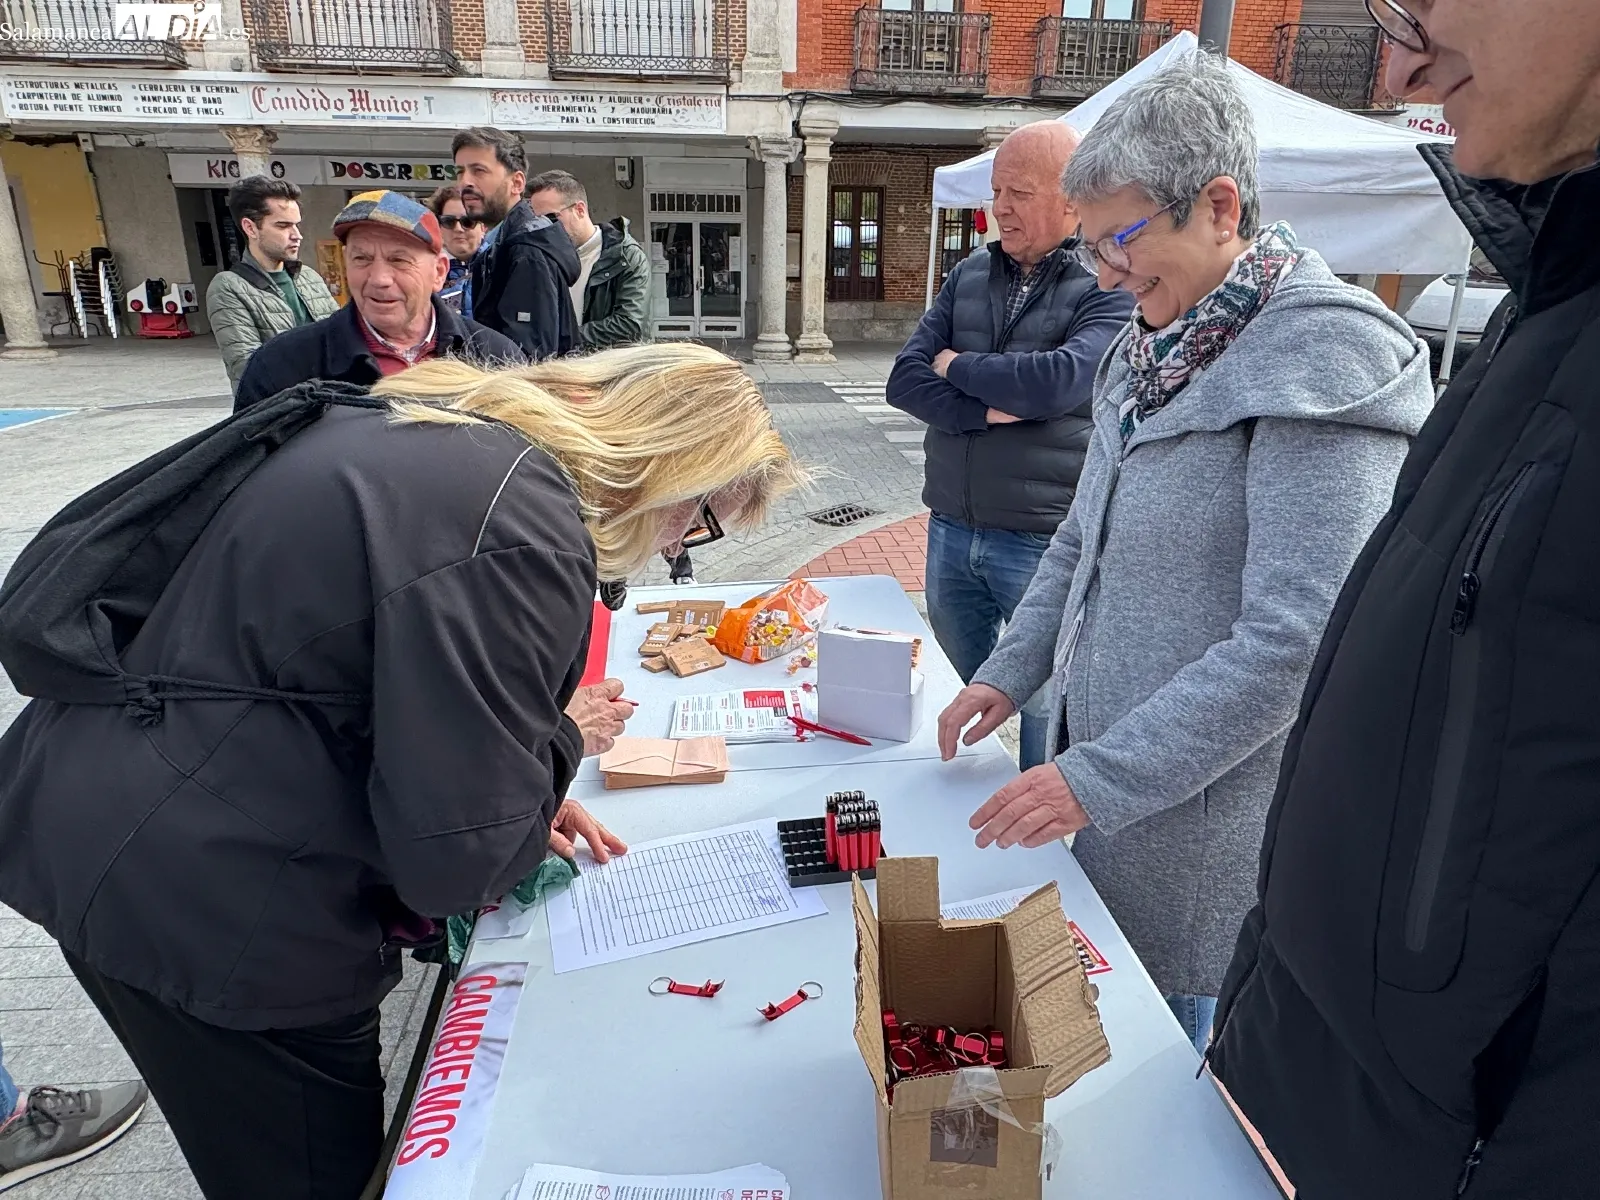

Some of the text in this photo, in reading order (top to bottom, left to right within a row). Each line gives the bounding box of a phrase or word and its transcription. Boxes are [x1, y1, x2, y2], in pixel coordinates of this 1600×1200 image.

[14, 81, 118, 91] ESTRUCTURAS METALICAS
[139, 84, 186, 93] CERRAJERIA
[190, 85, 201, 93] EN
[16, 92, 123, 101] CARPINTERIA DE ALUMINIO
[141, 95, 182, 104] MAMPARAS
[186, 96, 197, 104] DE
[608, 96, 643, 104] ALQUILER
[18, 103, 122, 112] ROTURA PUENTE TERMICO
[142, 106, 224, 115] CERCADO DE FINCAS
[542, 105, 597, 113] HERRAMIENTAS
[630, 107, 673, 115] MAQUINARIA
[561, 116, 579, 124] PARA
[602, 117, 656, 125] CONSTRUCCION
[397, 975, 497, 1166] CAMBIEMOS
